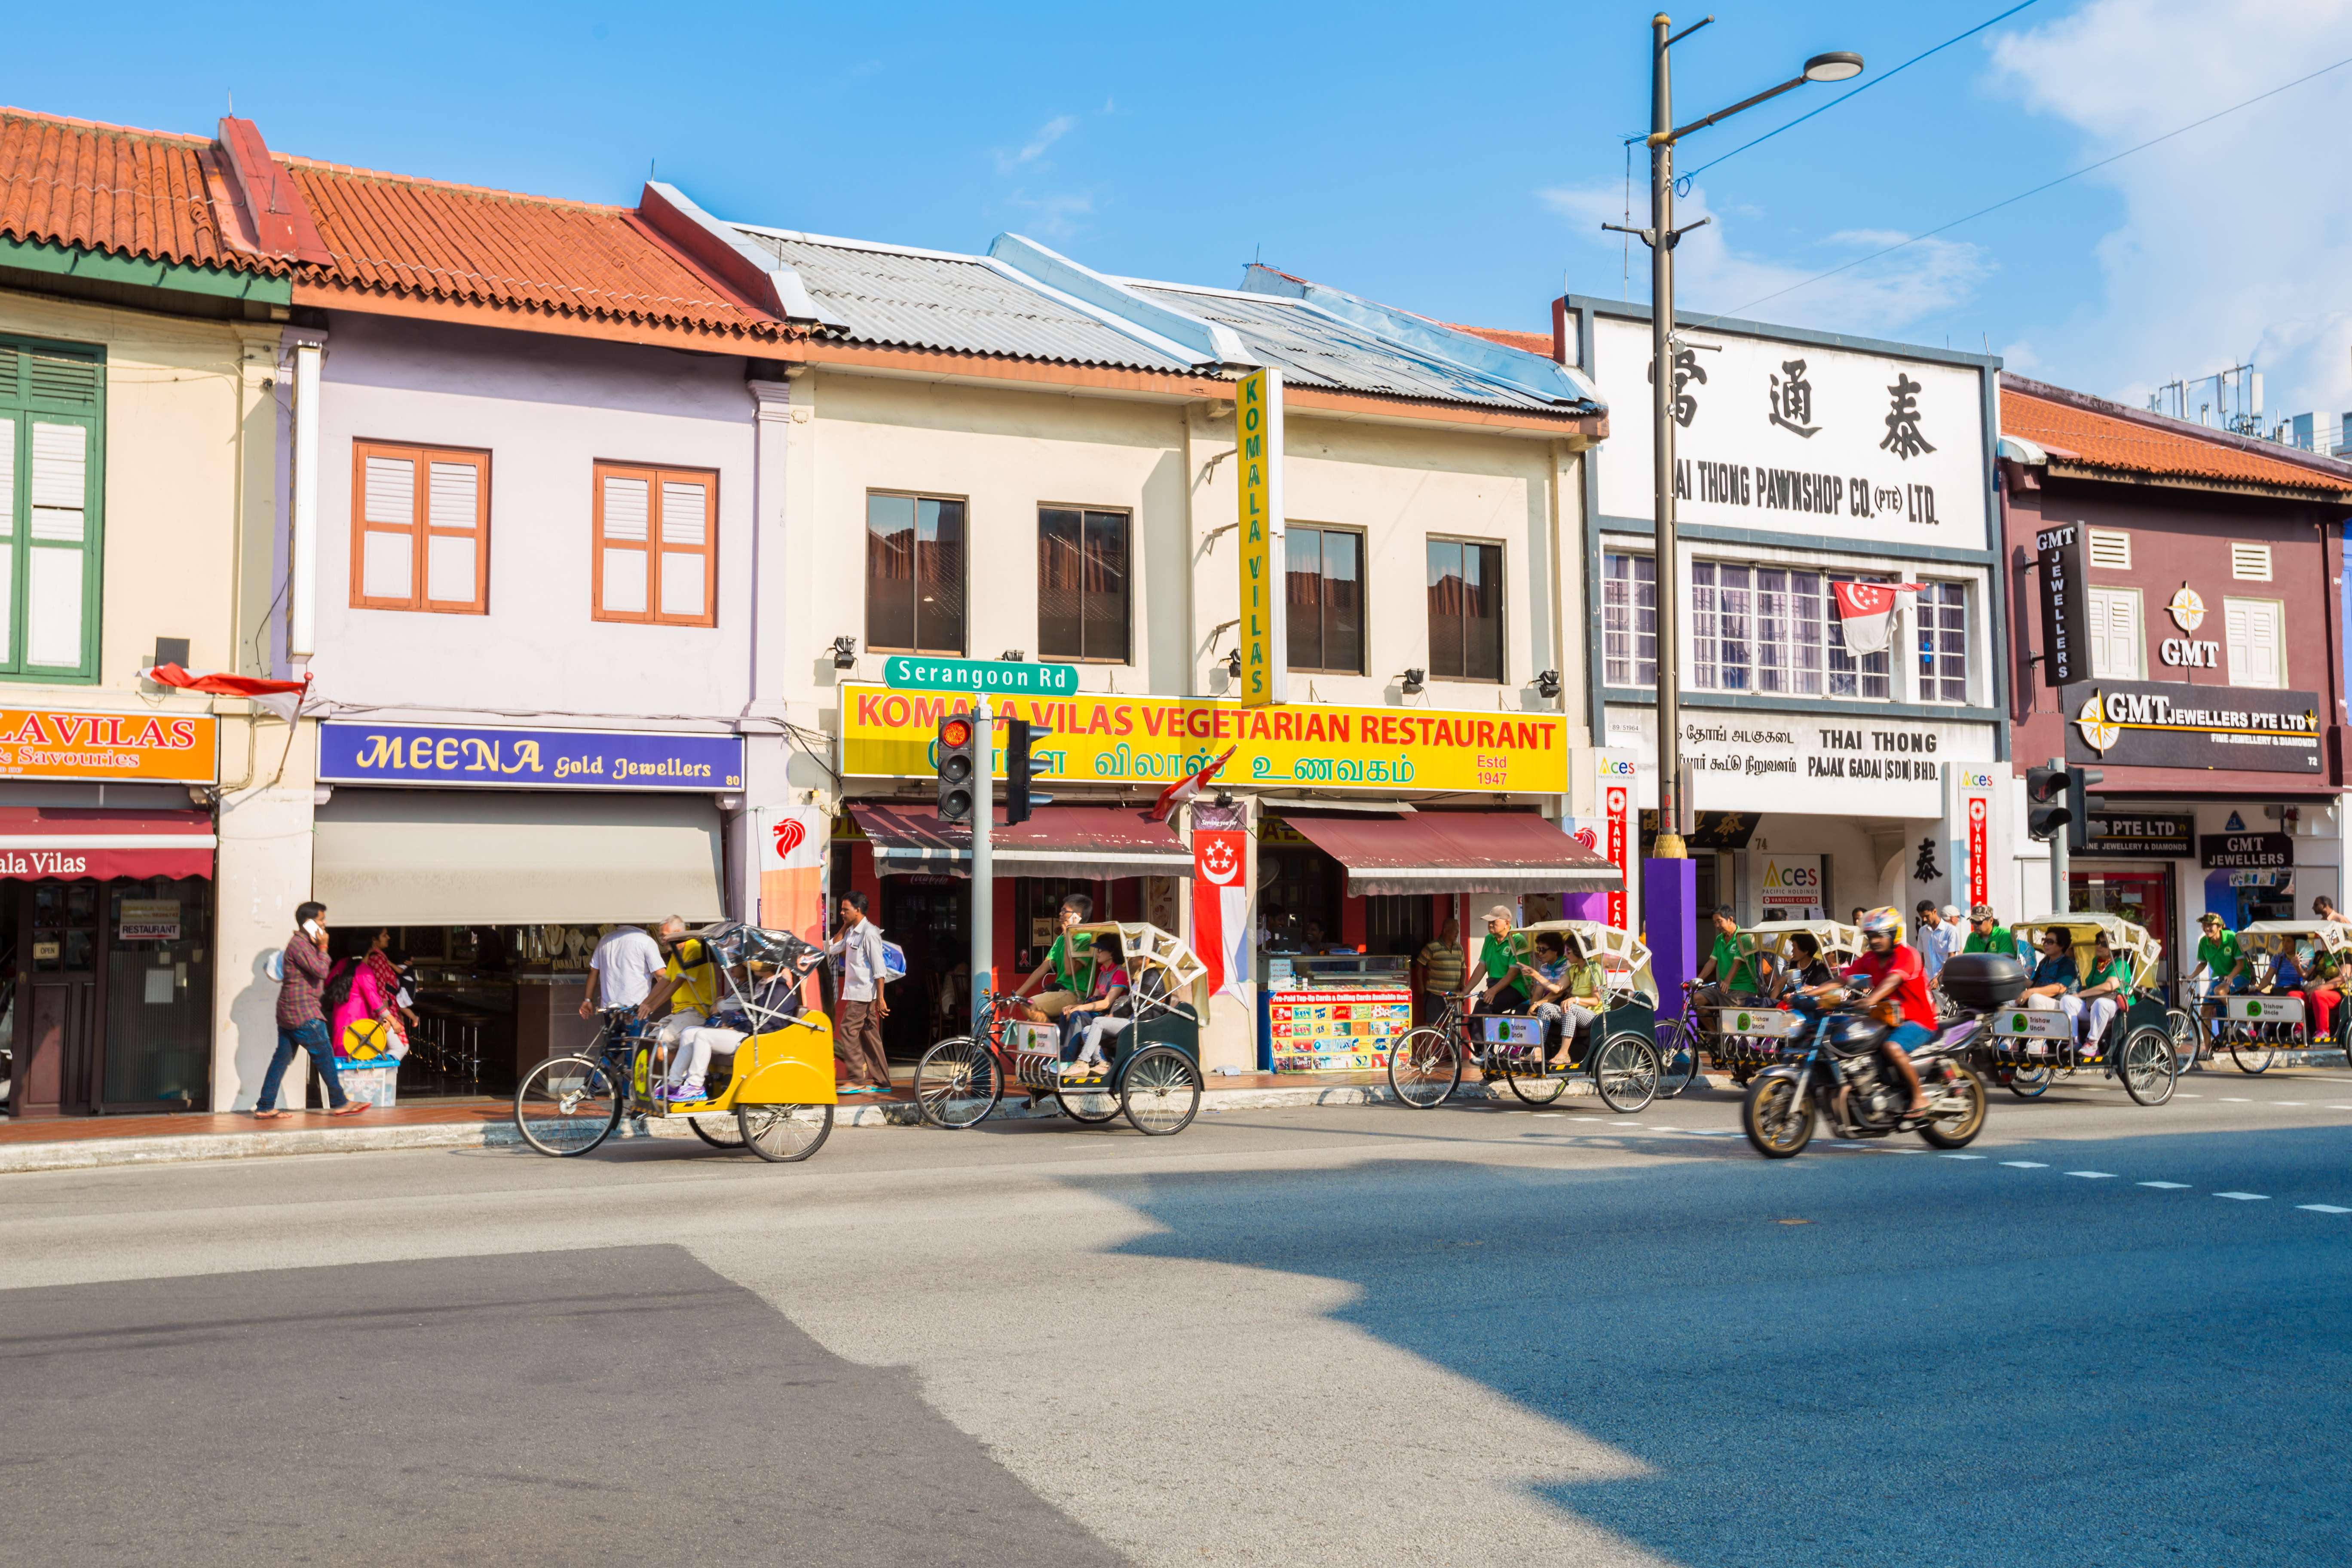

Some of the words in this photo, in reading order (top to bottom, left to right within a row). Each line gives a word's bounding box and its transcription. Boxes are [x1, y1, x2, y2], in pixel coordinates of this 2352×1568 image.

[1246, 379, 1261, 545] KOMALA
[1698, 460, 1750, 505] THONG
[1756, 467, 1843, 515] PAWNSHOP
[1850, 478, 1875, 518] CO.
[1874, 485, 1903, 514] (PTE)
[1908, 483, 1939, 525] LTD.
[2036, 527, 2075, 551] GMT
[1248, 555, 1263, 694] VILAS
[2050, 551, 2068, 678] JEWELLERS
[2161, 637, 2220, 668] GMT
[899, 660, 1028, 689] Serangoon
[1040, 668, 1066, 688] Rd
[2106, 693, 2170, 725] GMT
[2167, 708, 2249, 728] JEWELLERS
[2251, 712, 2278, 729] PTE
[2281, 714, 2306, 731] LTD
[1030, 701, 1134, 736] VILAS
[1141, 707, 1351, 743] VEGETARIAN
[1361, 714, 1556, 750] RESTAURANT
[1819, 729, 1862, 749] THAI
[1871, 731, 1937, 753] THONG
[2211, 733, 2229, 743] FINE
[2229, 734, 2271, 745] JEWELLERY
[2272, 736, 2279, 746] &
[2279, 737, 2318, 747] DIAMONDS
[18, 747, 140, 767] Savouries
[356, 735, 543, 774] MEENA
[554, 755, 603, 778] Gold
[612, 758, 711, 780] Jewellers
[1477, 755, 1507, 769] Estd
[1599, 756, 1635, 774] Aces
[2307, 756, 2318, 766] 72
[1477, 772, 1507, 786] 1947
[1808, 756, 1845, 777] PAJAK
[1850, 758, 1882, 778] GADAI
[1885, 758, 1911, 782] (SDN)
[1914, 761, 1938, 781] BHD.
[1961, 770, 1993, 786] Aces
[726, 775, 739, 786] 80
[2113, 821, 2142, 835] PTE
[2147, 821, 2175, 836] LTD
[1755, 838, 1768, 850] 74
[2227, 837, 2264, 851] GMT
[30, 852, 86, 873] Vilas
[1973, 823, 1982, 896] VANTAGE
[2209, 853, 2285, 866] JEWELLERS
[1763, 859, 1817, 886] Aces
[2062, 871, 2067, 881] 2
[122, 925, 177, 934] RESTAURANT
[1296, 994, 1315, 1002] Top-Up
[1315, 994, 1332, 1002] Cards
[1336, 993, 1354, 1002] Calling
[1356, 993, 1372, 1001] Cards
[1372, 993, 1396, 1001] Available
